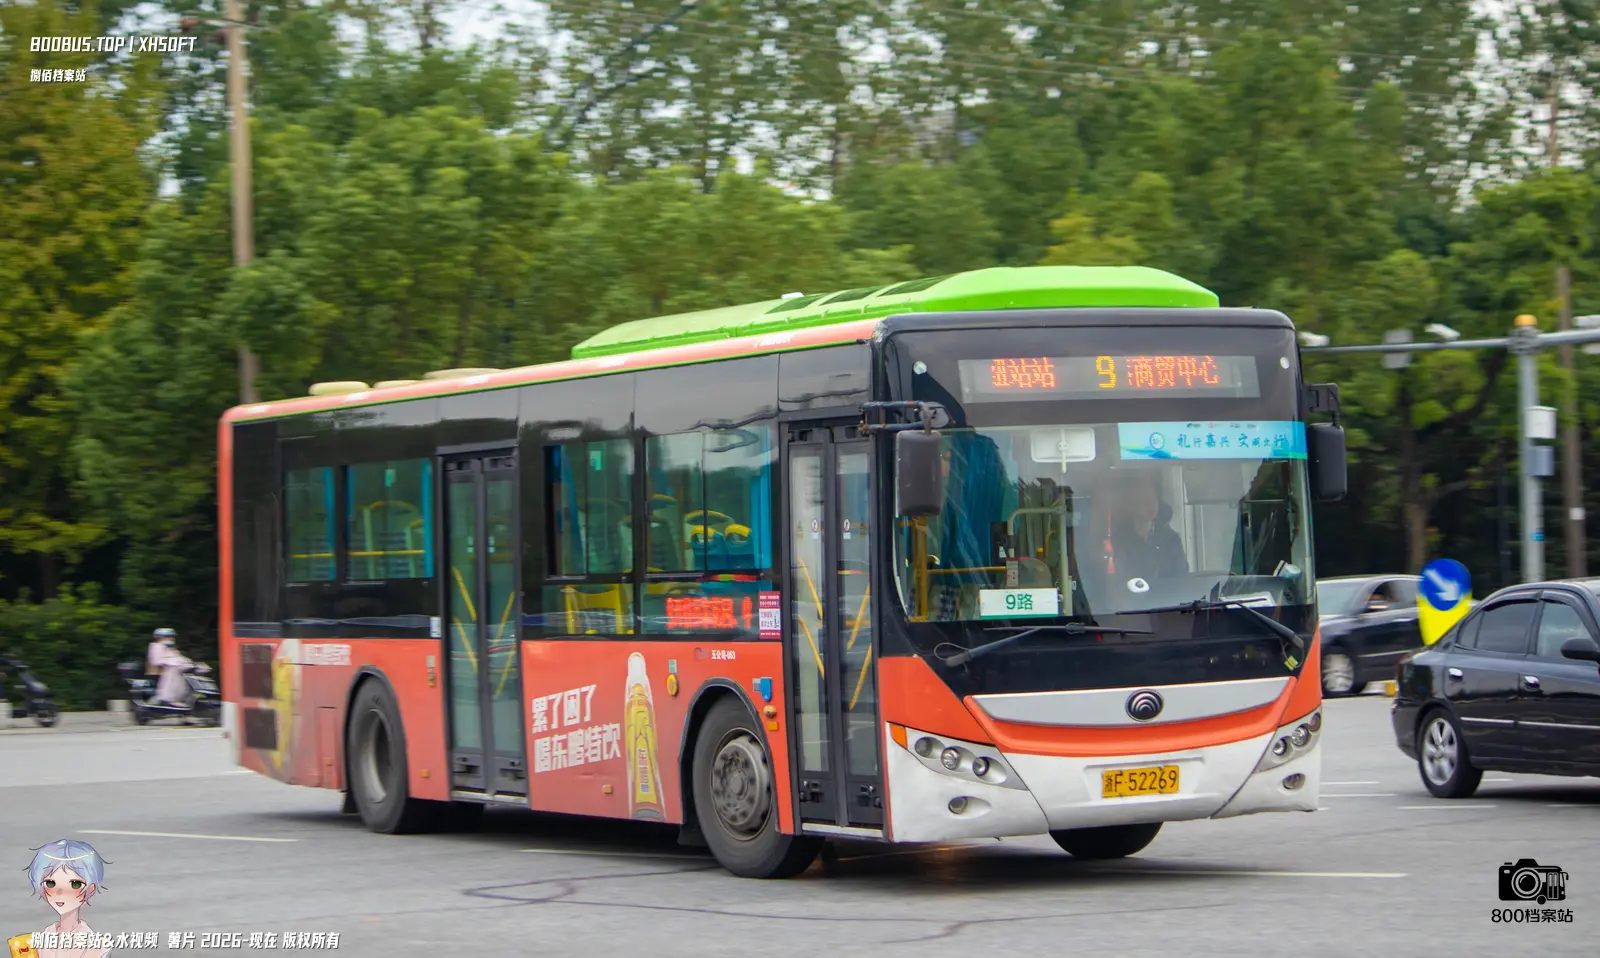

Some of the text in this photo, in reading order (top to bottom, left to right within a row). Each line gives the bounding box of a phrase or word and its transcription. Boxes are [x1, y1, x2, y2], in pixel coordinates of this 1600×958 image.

[1095, 355, 1116, 388] 9
[1005, 593, 1034, 611] 9路
[532, 684, 597, 734] 累了困了
